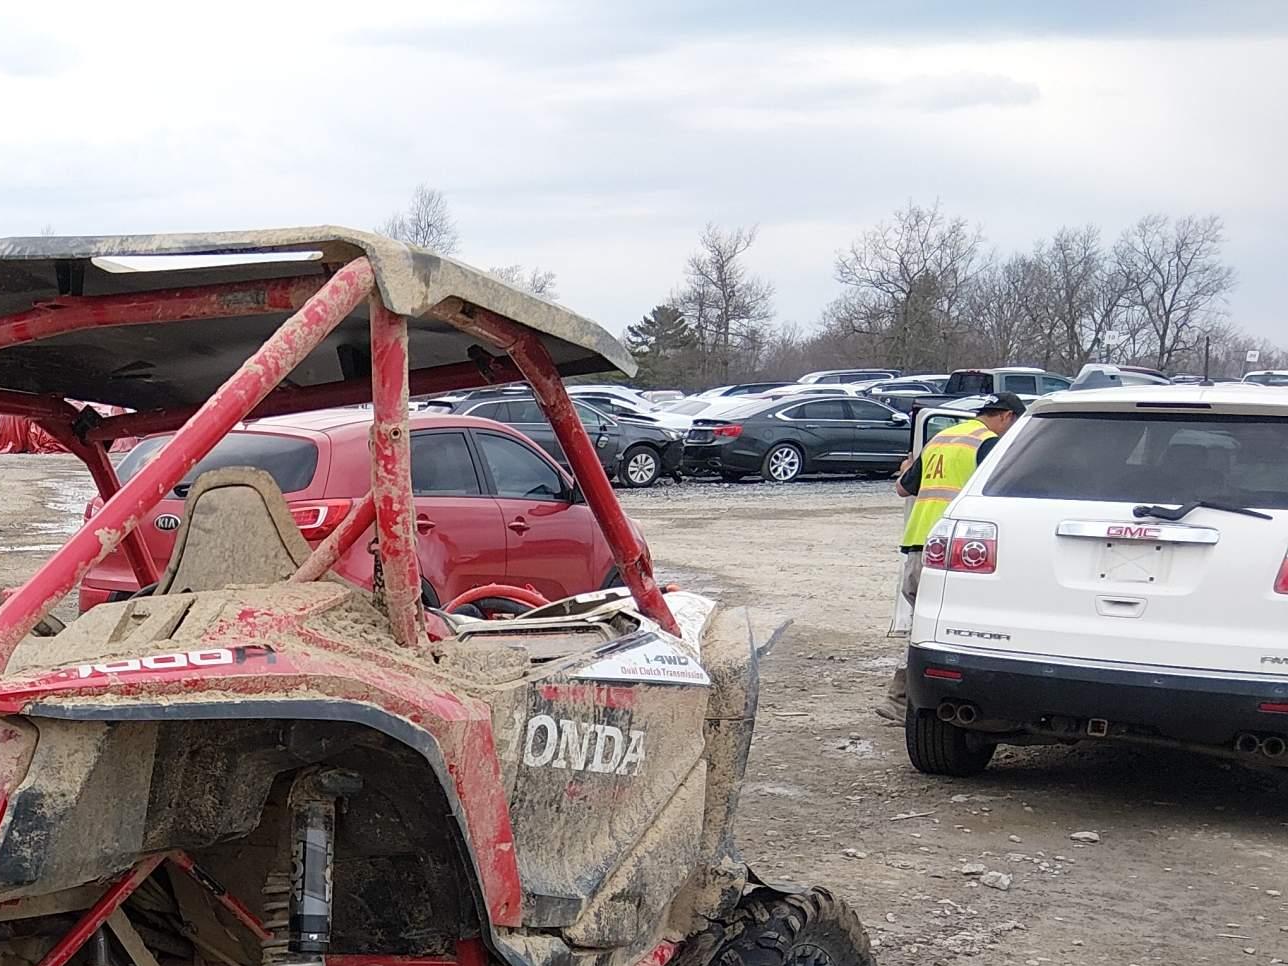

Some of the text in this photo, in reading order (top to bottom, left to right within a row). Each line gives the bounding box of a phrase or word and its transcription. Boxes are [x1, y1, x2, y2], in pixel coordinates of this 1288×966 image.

[158, 518, 175, 528] KIA
[1106, 526, 1161, 538] GMC
[945, 628, 1011, 641] ACADIA
[620, 666, 704, 680] Dual Clutch Transmission
